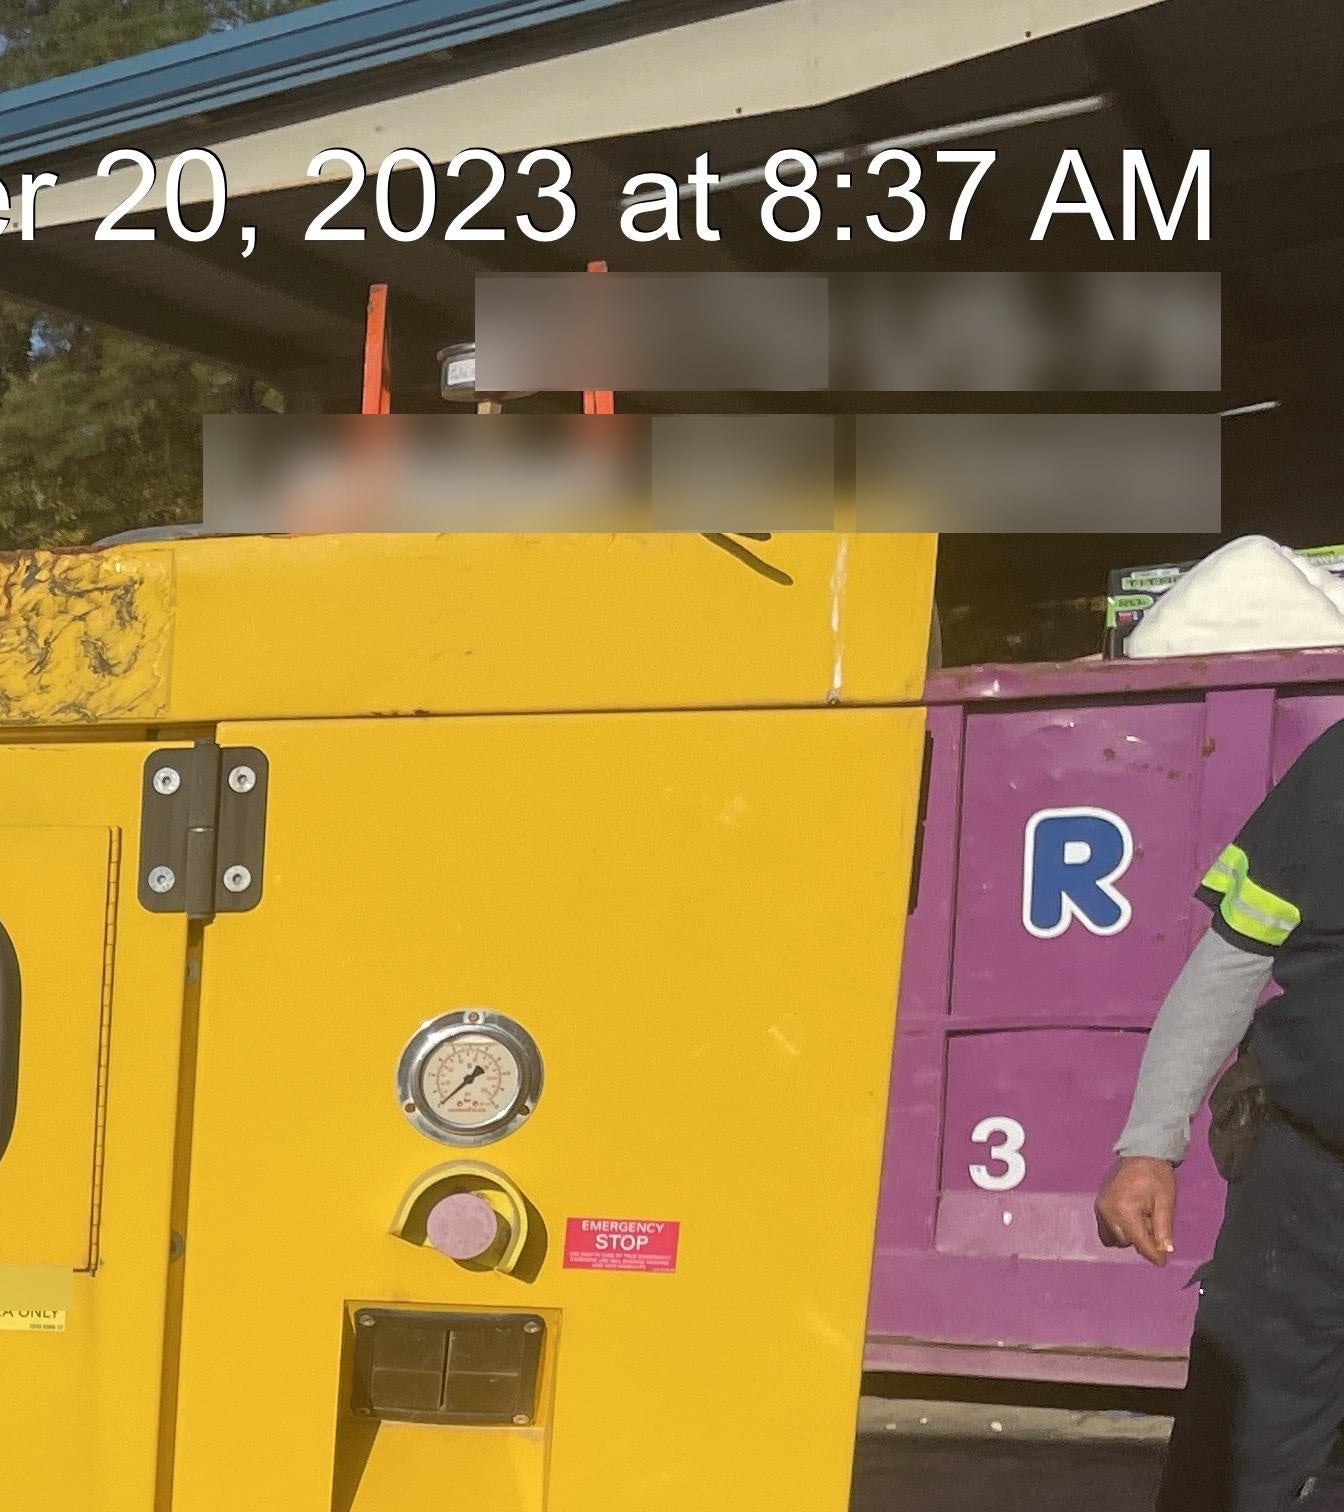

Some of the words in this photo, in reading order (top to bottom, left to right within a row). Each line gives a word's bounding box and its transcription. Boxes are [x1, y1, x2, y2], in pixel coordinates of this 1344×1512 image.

[1022, 806, 1133, 939] R
[968, 1116, 1026, 1191] 3
[581, 1220, 665, 1233] EMERGENCY
[595, 1233, 649, 1251] STOP
